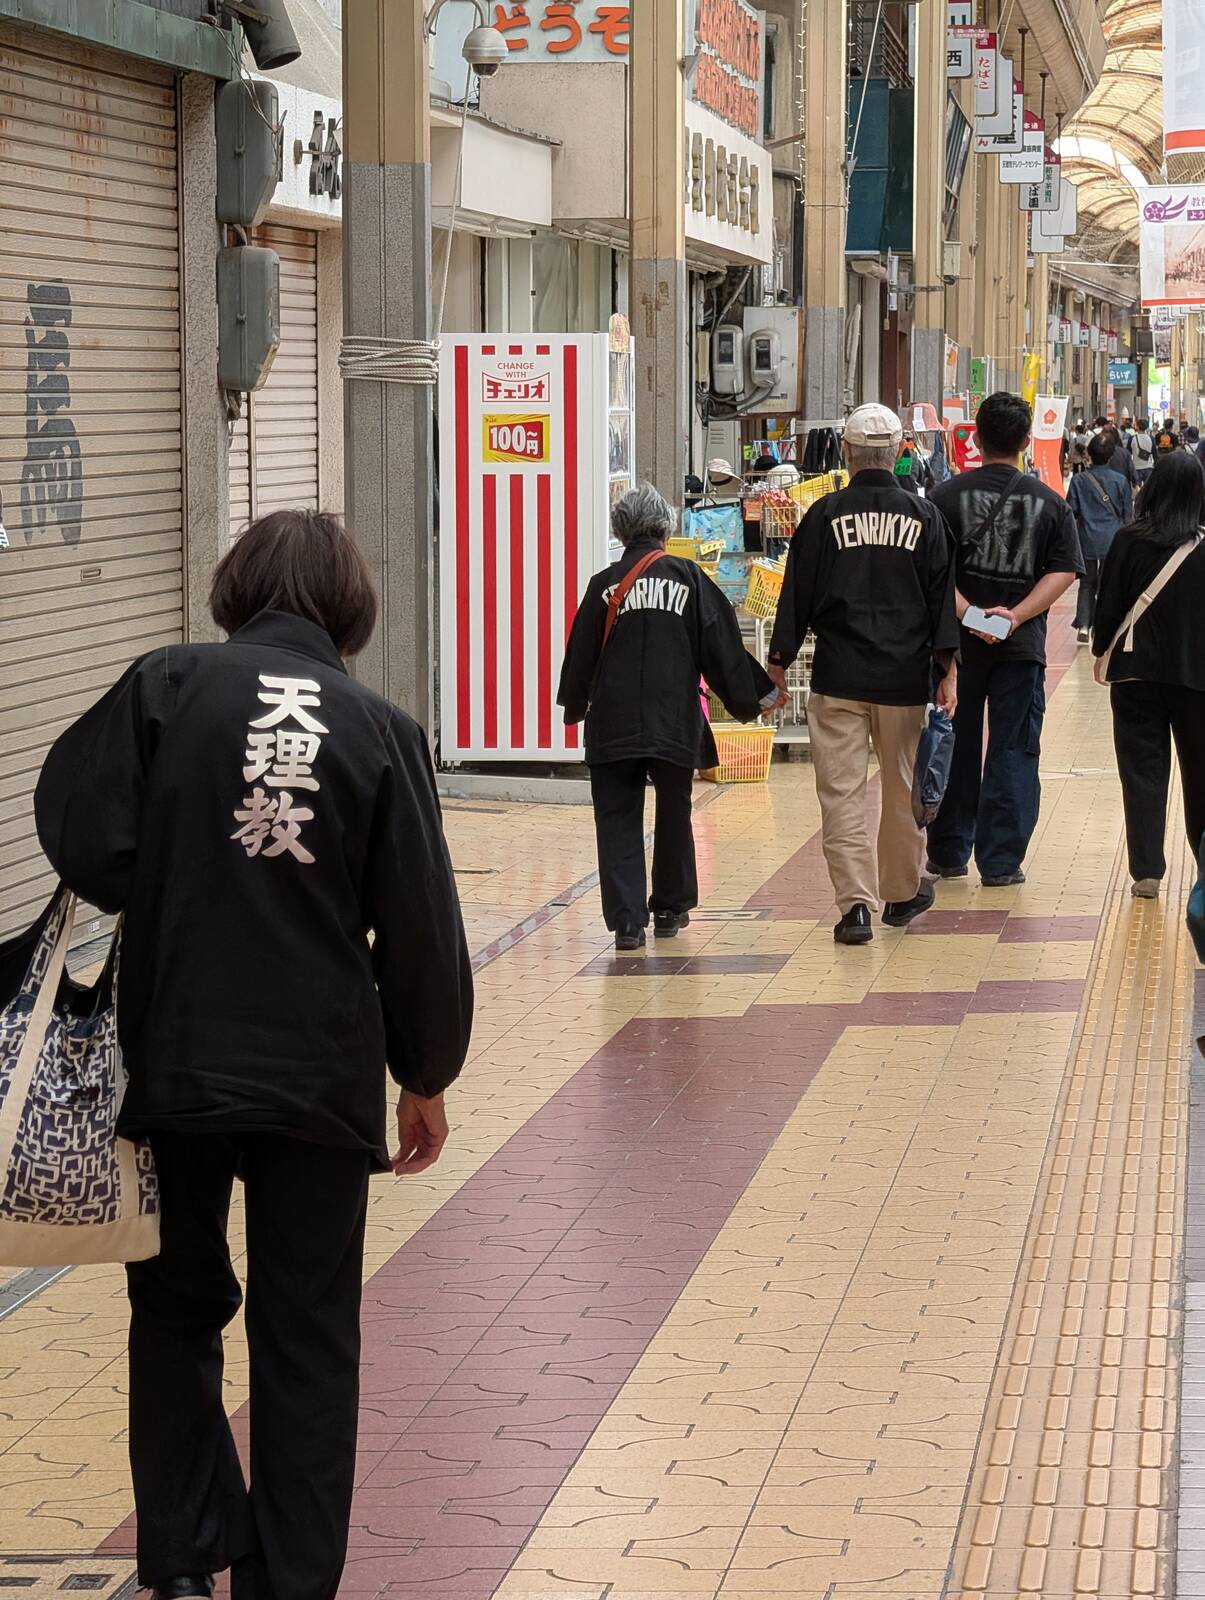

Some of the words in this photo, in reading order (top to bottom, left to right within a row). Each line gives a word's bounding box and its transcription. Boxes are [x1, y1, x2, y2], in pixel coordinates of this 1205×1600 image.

[978, 57, 991, 90] たばこ
[497, 362, 535, 370] CHANGE
[505, 371, 527, 379] WITH
[486, 379, 546, 399] チェリオ
[831, 512, 923, 552] TENRIKYO
[229, 674, 330, 864] 天理教
